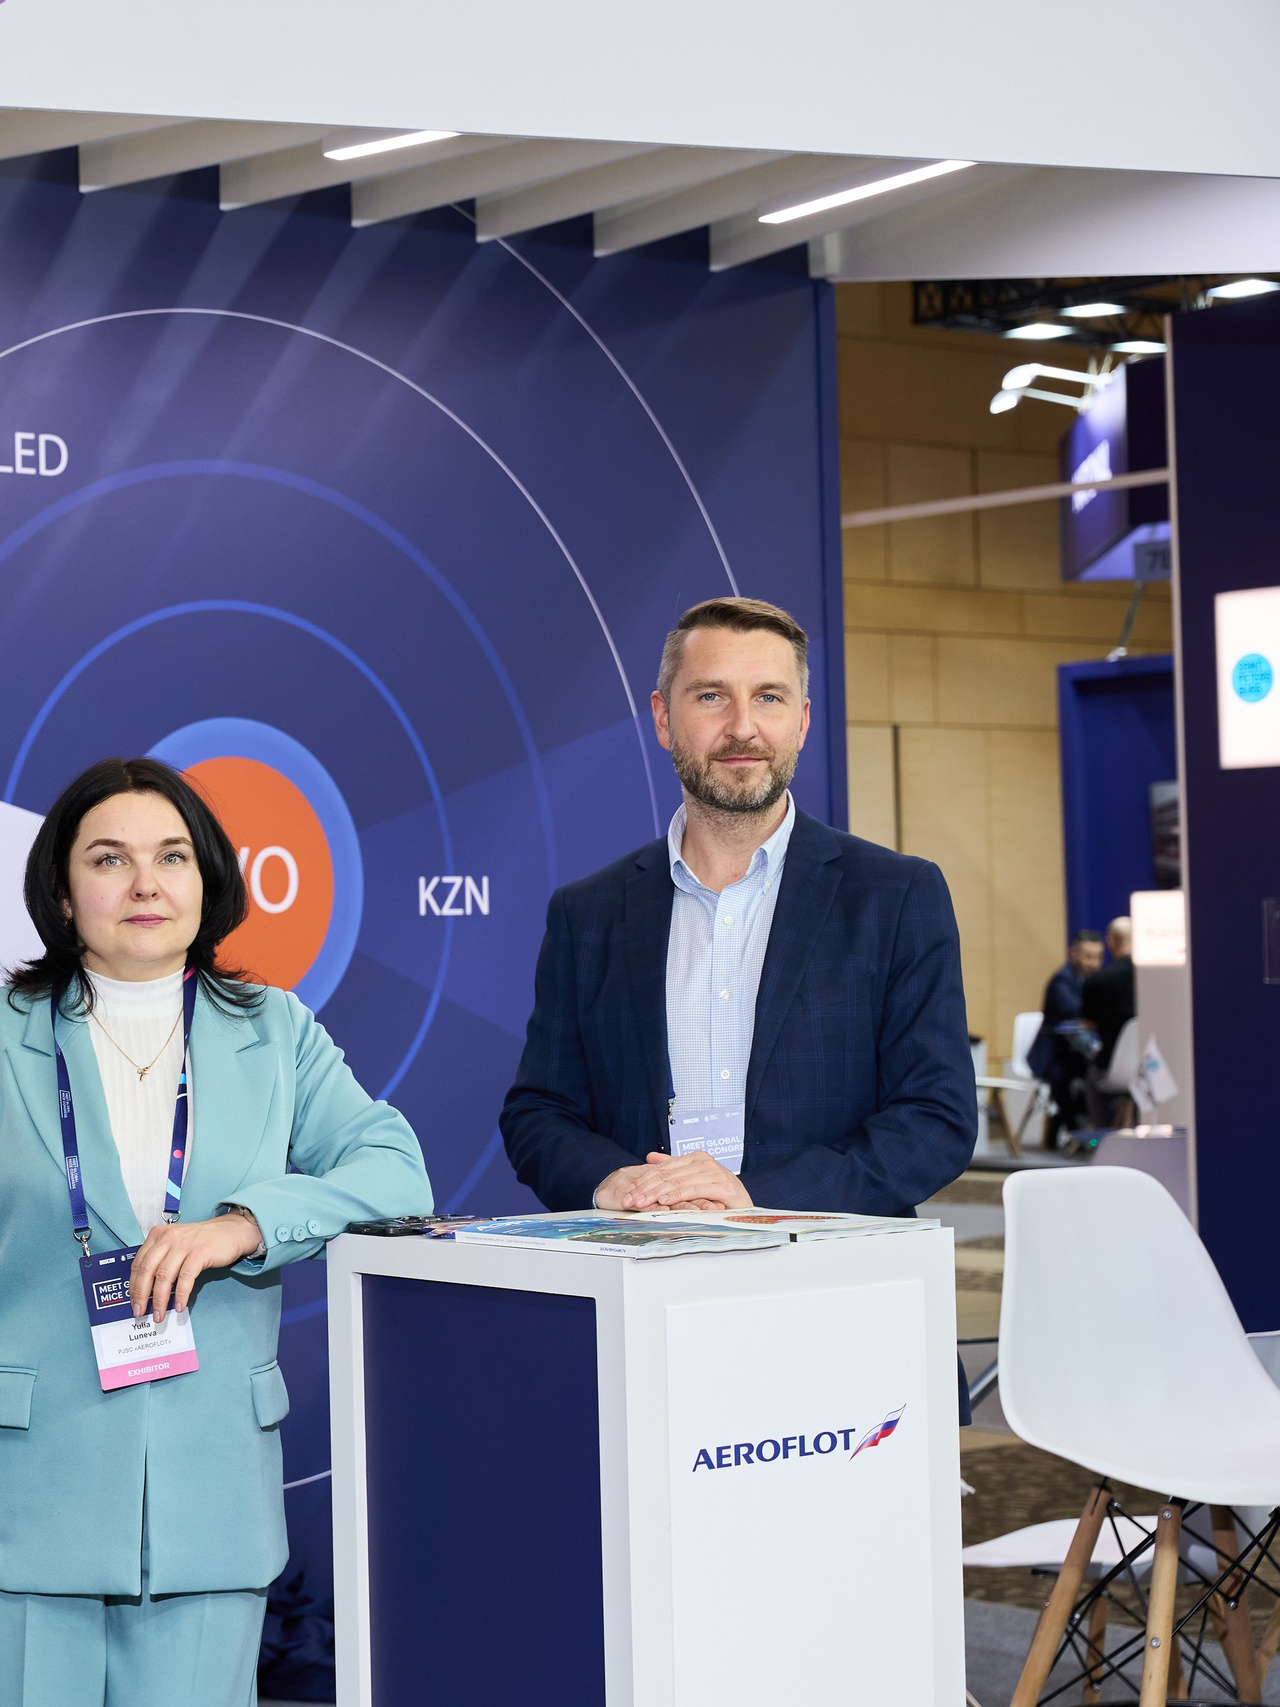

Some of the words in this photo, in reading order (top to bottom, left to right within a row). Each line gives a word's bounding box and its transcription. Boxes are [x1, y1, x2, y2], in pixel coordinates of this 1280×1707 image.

[418, 875, 490, 916] KZN
[683, 1141, 705, 1151] MEET
[707, 1136, 741, 1147] GLOBAL
[99, 1282, 122, 1293] MEET
[101, 1292, 123, 1302] MICE
[131, 1321, 151, 1330] Yulia
[128, 1330, 157, 1341] Luneva
[117, 1346, 133, 1354] PJSC
[128, 1363, 170, 1376] EXHIBITOR
[692, 1428, 856, 1473] AEROFLOT
